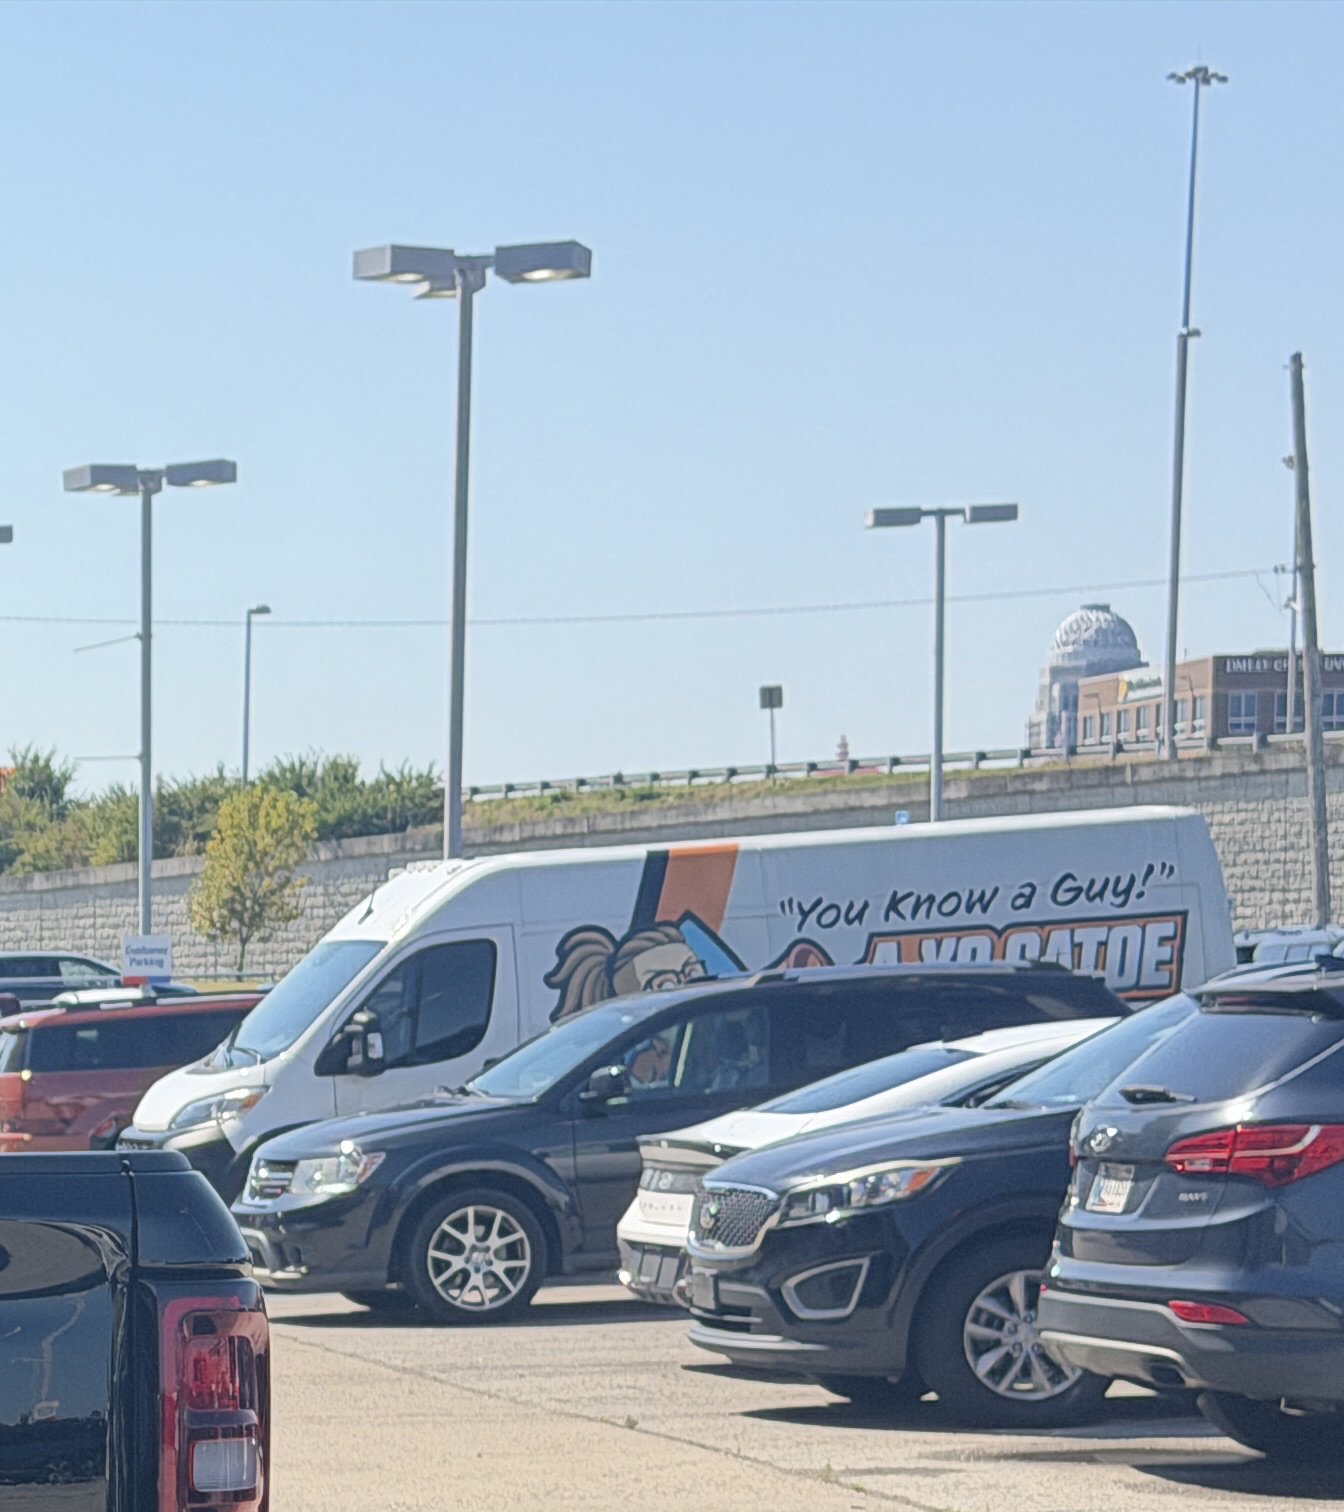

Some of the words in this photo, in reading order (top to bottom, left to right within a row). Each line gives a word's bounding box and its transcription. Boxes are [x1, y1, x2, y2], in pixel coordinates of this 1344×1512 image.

[780, 896, 869, 932] "You
[883, 886, 1004, 922] Know
[1010, 881, 1037, 911] a
[1050, 861, 1175, 908] Guy!"
